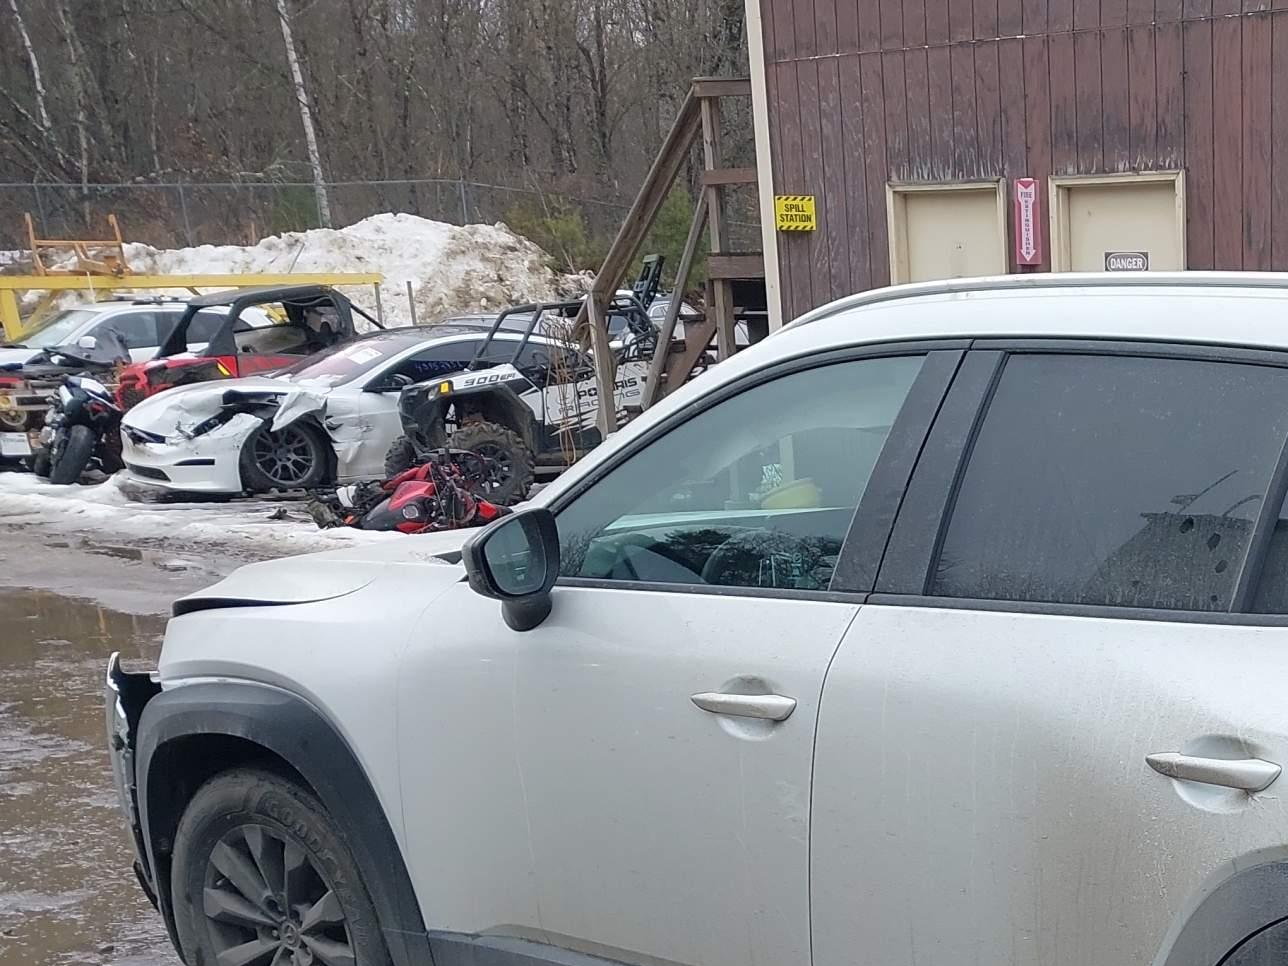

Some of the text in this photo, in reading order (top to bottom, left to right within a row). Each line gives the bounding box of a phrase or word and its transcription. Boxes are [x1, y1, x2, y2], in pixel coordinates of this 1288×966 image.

[784, 203, 806, 212] SPILL
[780, 213, 812, 222] STATION
[1110, 257, 1143, 269] DANGER
